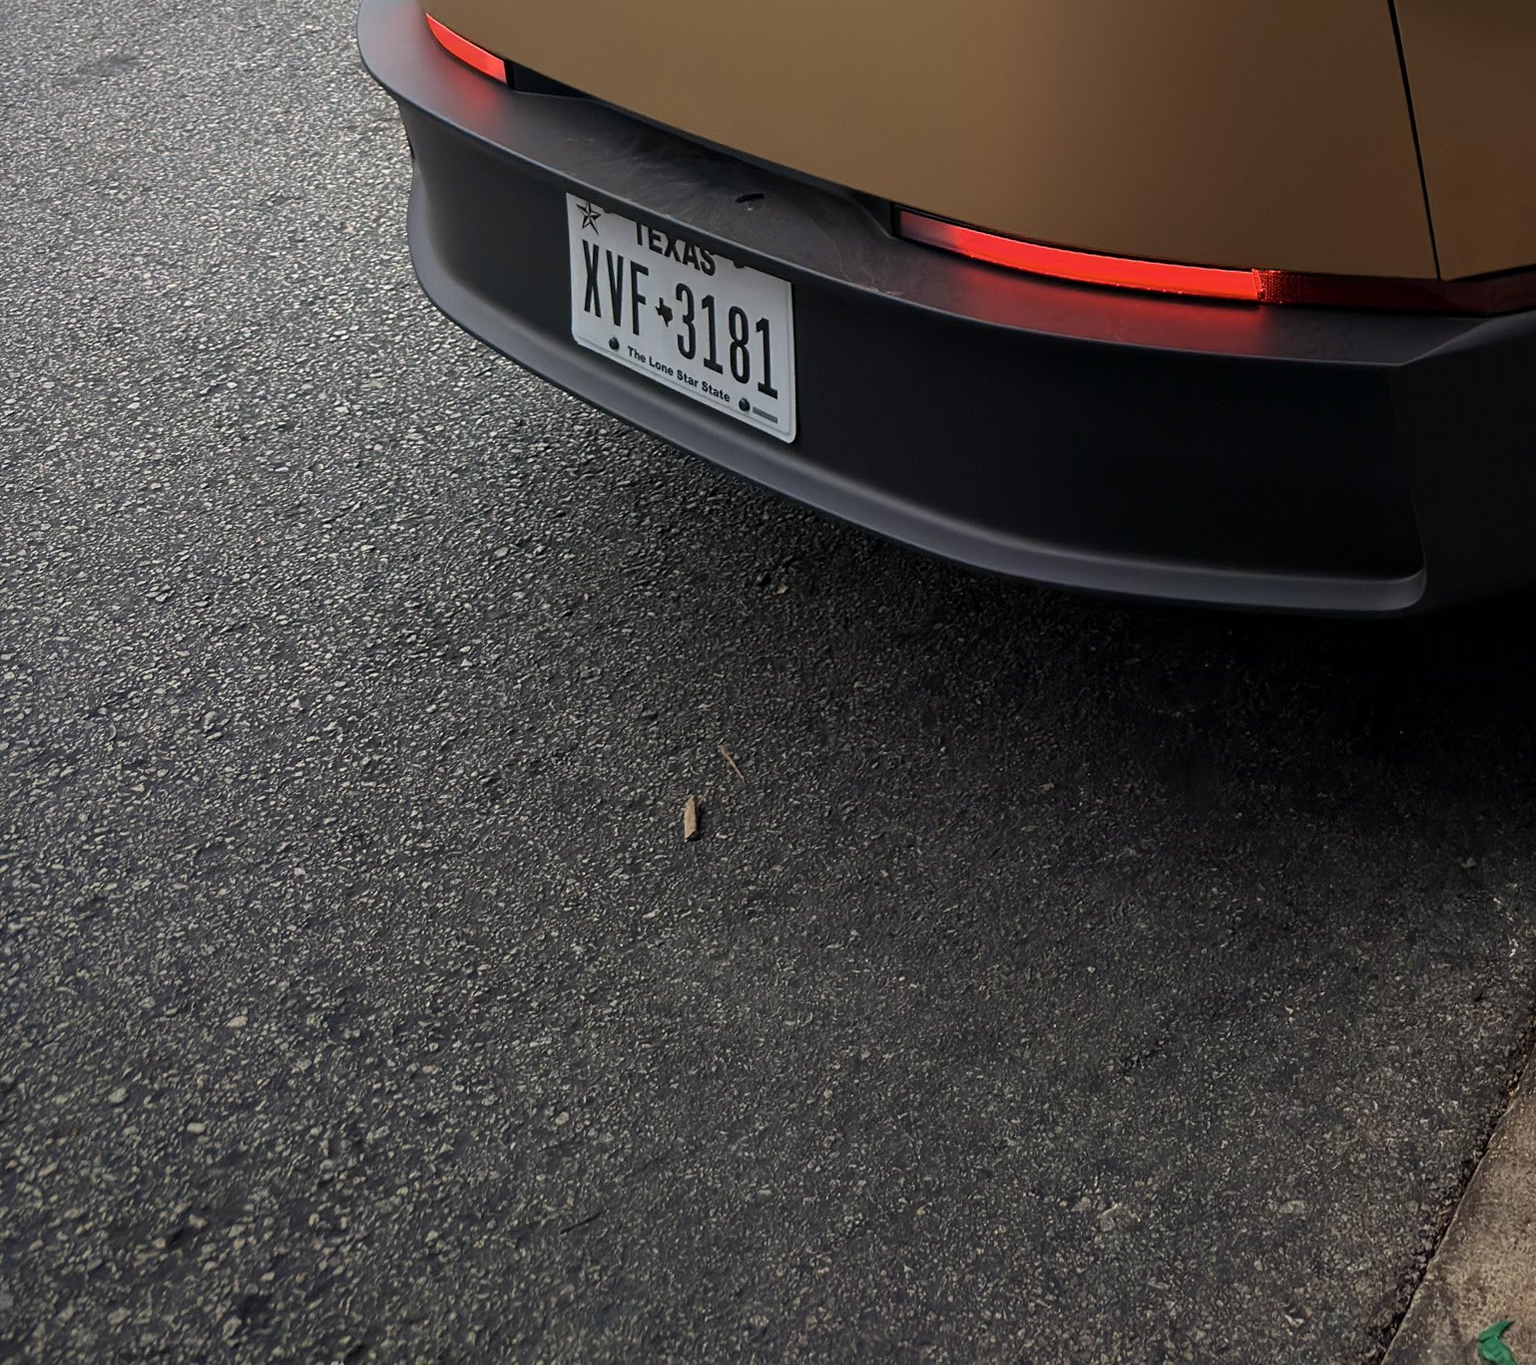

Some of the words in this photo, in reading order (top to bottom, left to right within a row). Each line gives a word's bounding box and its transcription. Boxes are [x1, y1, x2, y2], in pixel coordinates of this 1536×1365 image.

[635, 222, 716, 277] TEXAS
[627, 345, 646, 363] The
[649, 356, 674, 376] Lone
[676, 369, 699, 388] Star
[701, 381, 731, 402] State
